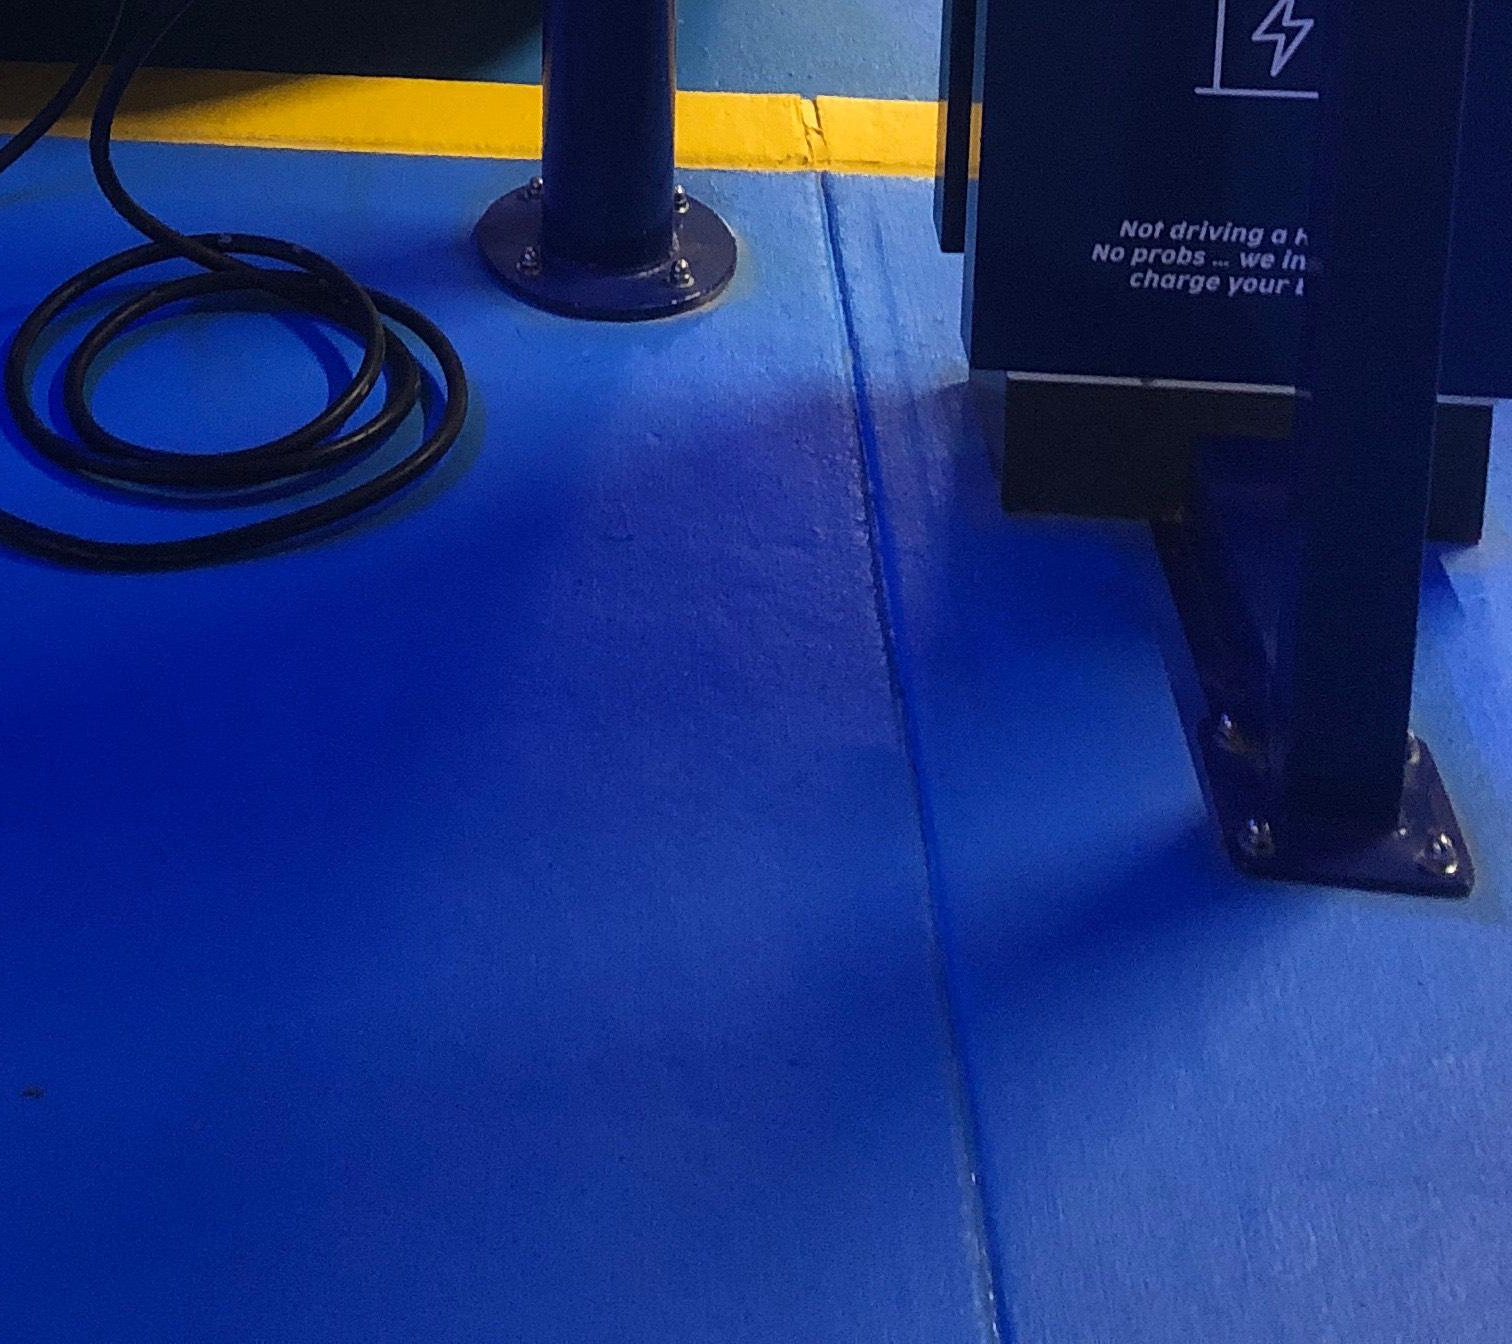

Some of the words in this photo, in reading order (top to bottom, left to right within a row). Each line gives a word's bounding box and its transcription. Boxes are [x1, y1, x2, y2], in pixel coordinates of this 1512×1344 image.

[1119, 219, 1165, 240] Not
[1170, 220, 1264, 248] driving
[1271, 229, 1288, 245] a
[1091, 243, 1125, 263] No
[1130, 245, 1206, 267] probs
[1239, 253, 1276, 270] we
[1129, 268, 1221, 296] charge
[1228, 275, 1290, 298] your
